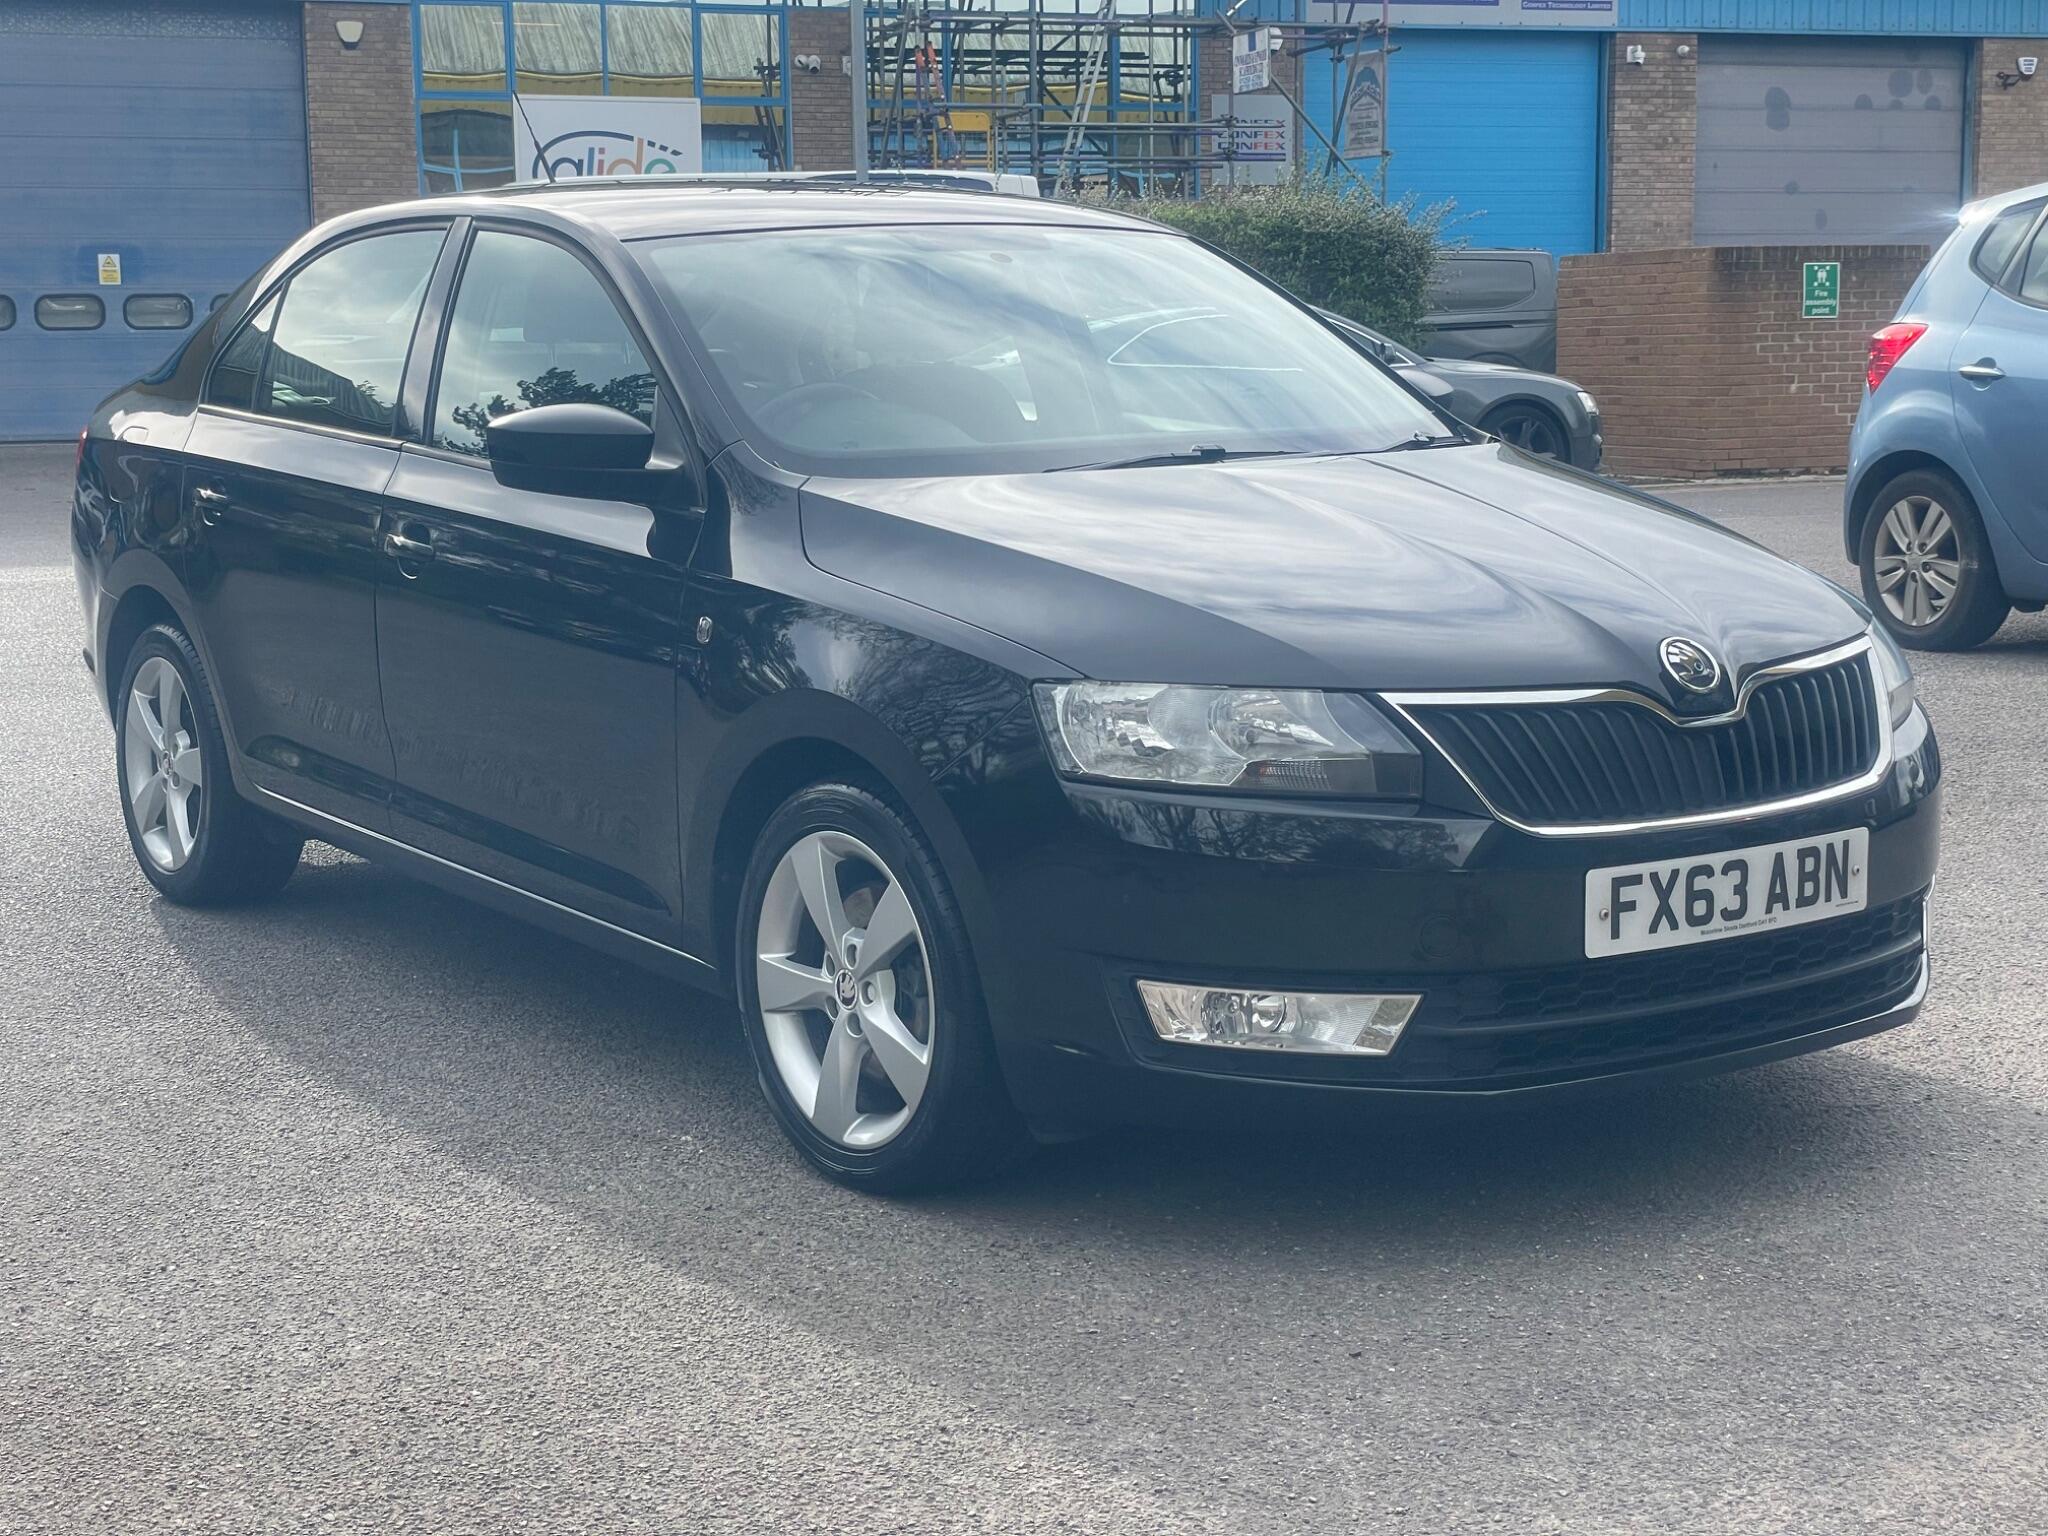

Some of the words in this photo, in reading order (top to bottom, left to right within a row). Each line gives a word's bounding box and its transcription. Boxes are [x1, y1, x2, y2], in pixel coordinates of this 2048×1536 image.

[1805, 299, 1836, 307] assembly
[1811, 307, 1830, 315] point
[1610, 859, 1749, 940] FX63
[1765, 839, 1850, 915] ABN
